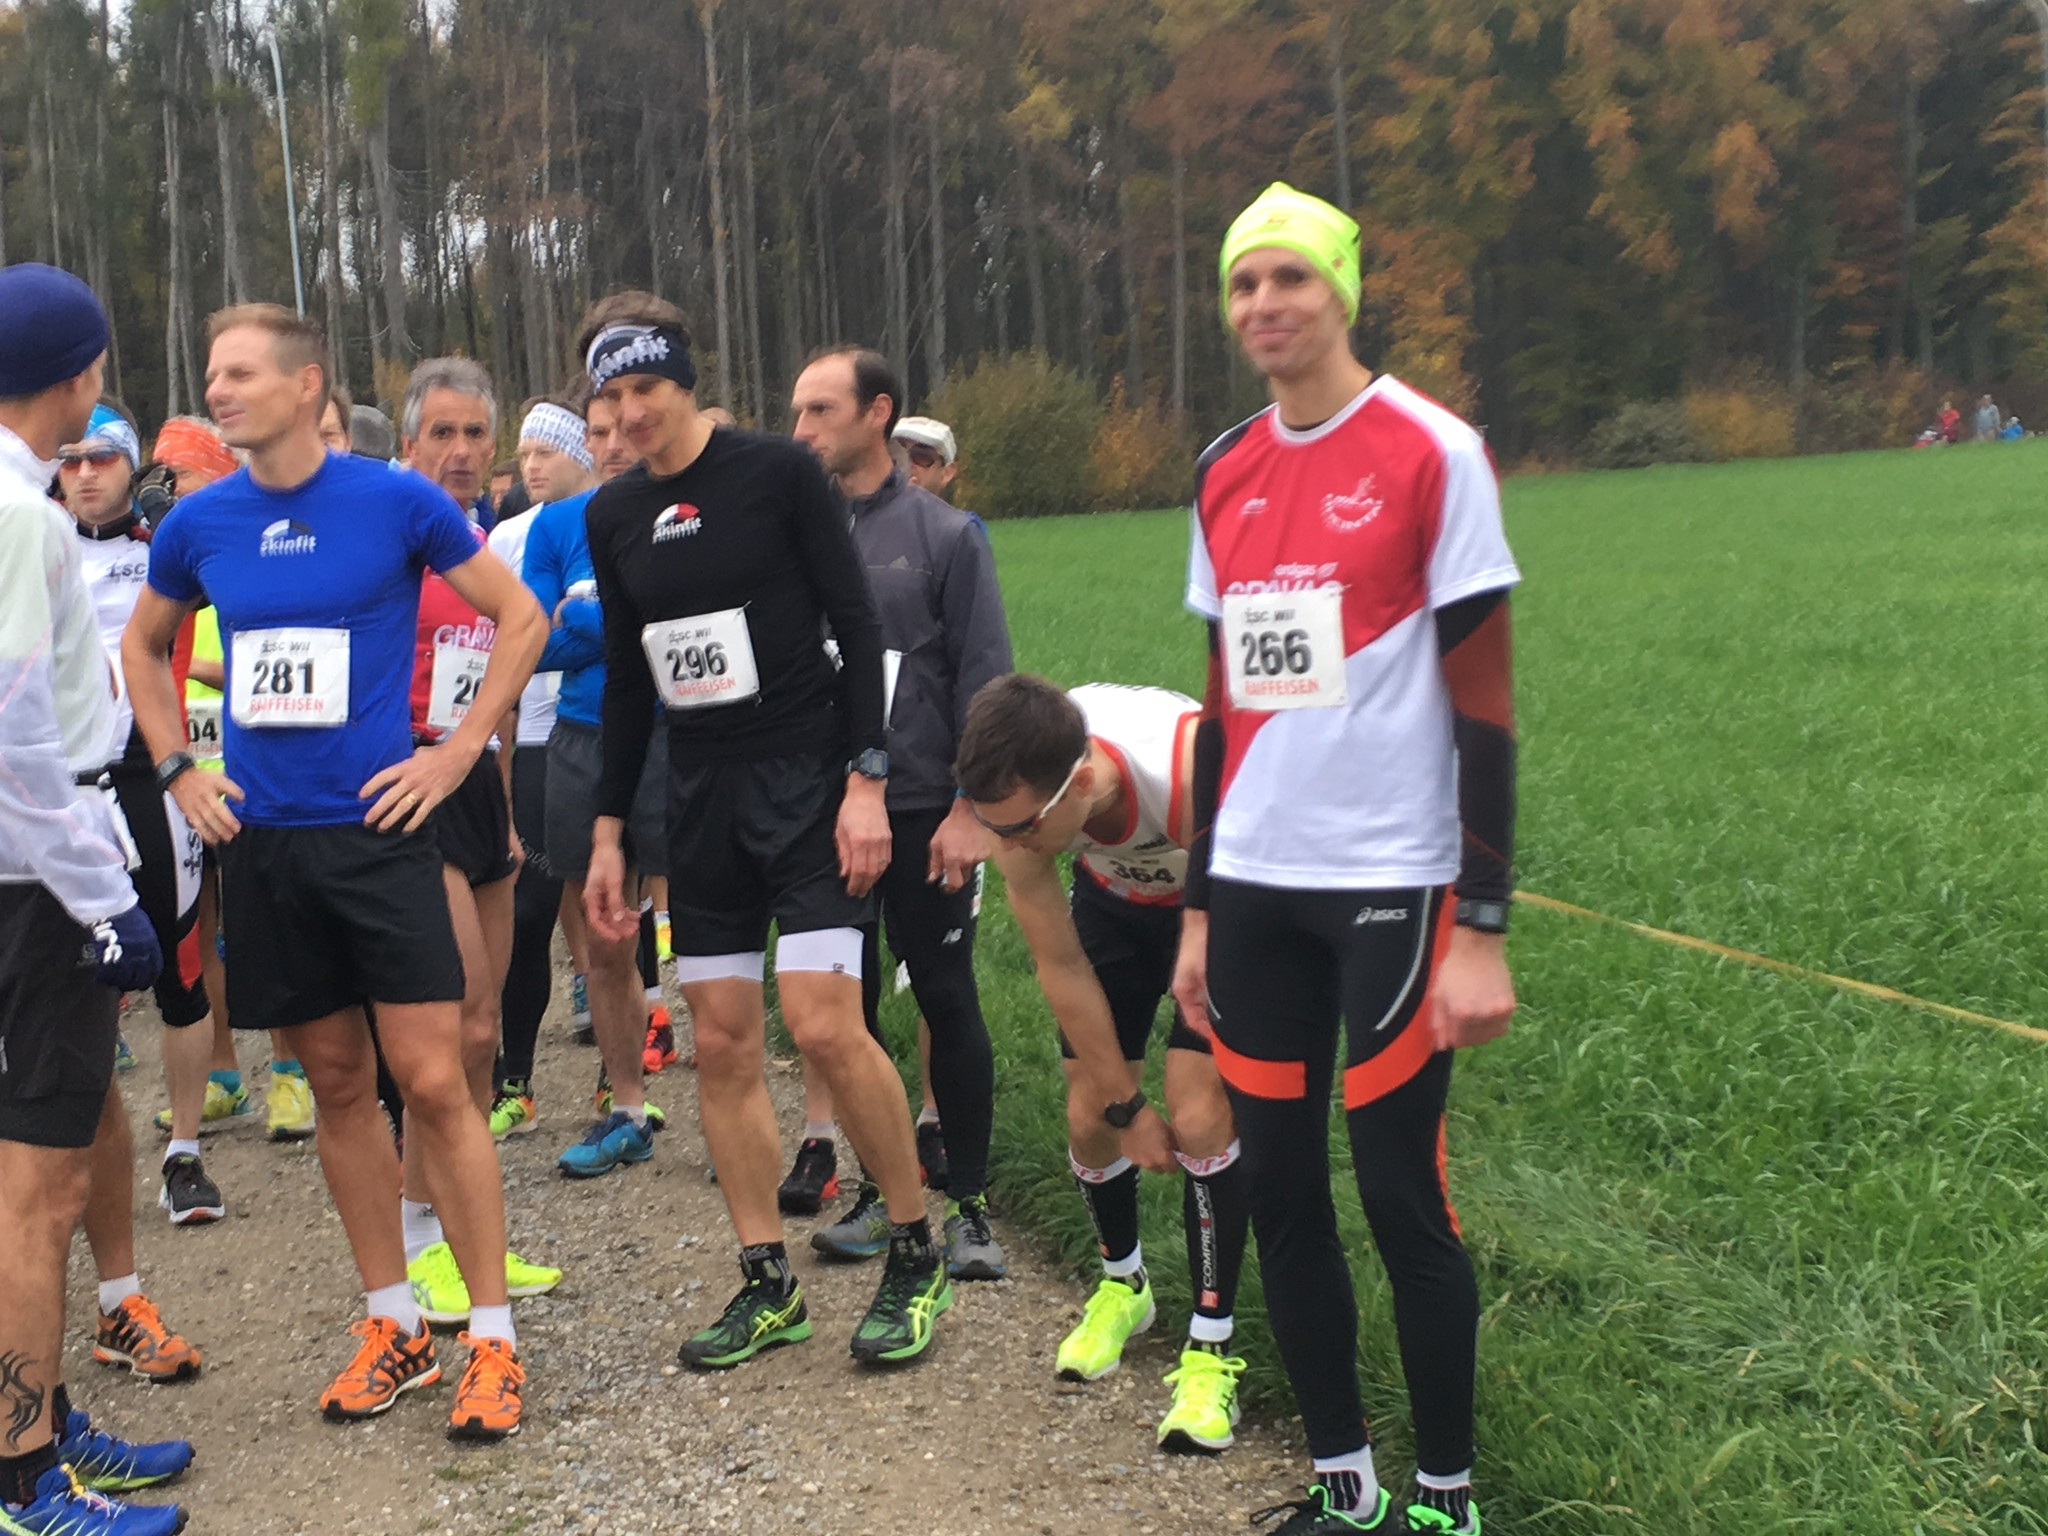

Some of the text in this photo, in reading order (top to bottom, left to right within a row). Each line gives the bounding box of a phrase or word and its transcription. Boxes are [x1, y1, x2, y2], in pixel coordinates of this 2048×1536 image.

[259, 534, 317, 554] skinfit
[653, 516, 702, 541] skinfit
[666, 641, 729, 681] 296
[1240, 629, 1313, 676] 266
[252, 657, 315, 694] 281
[1109, 860, 1176, 883] 364
